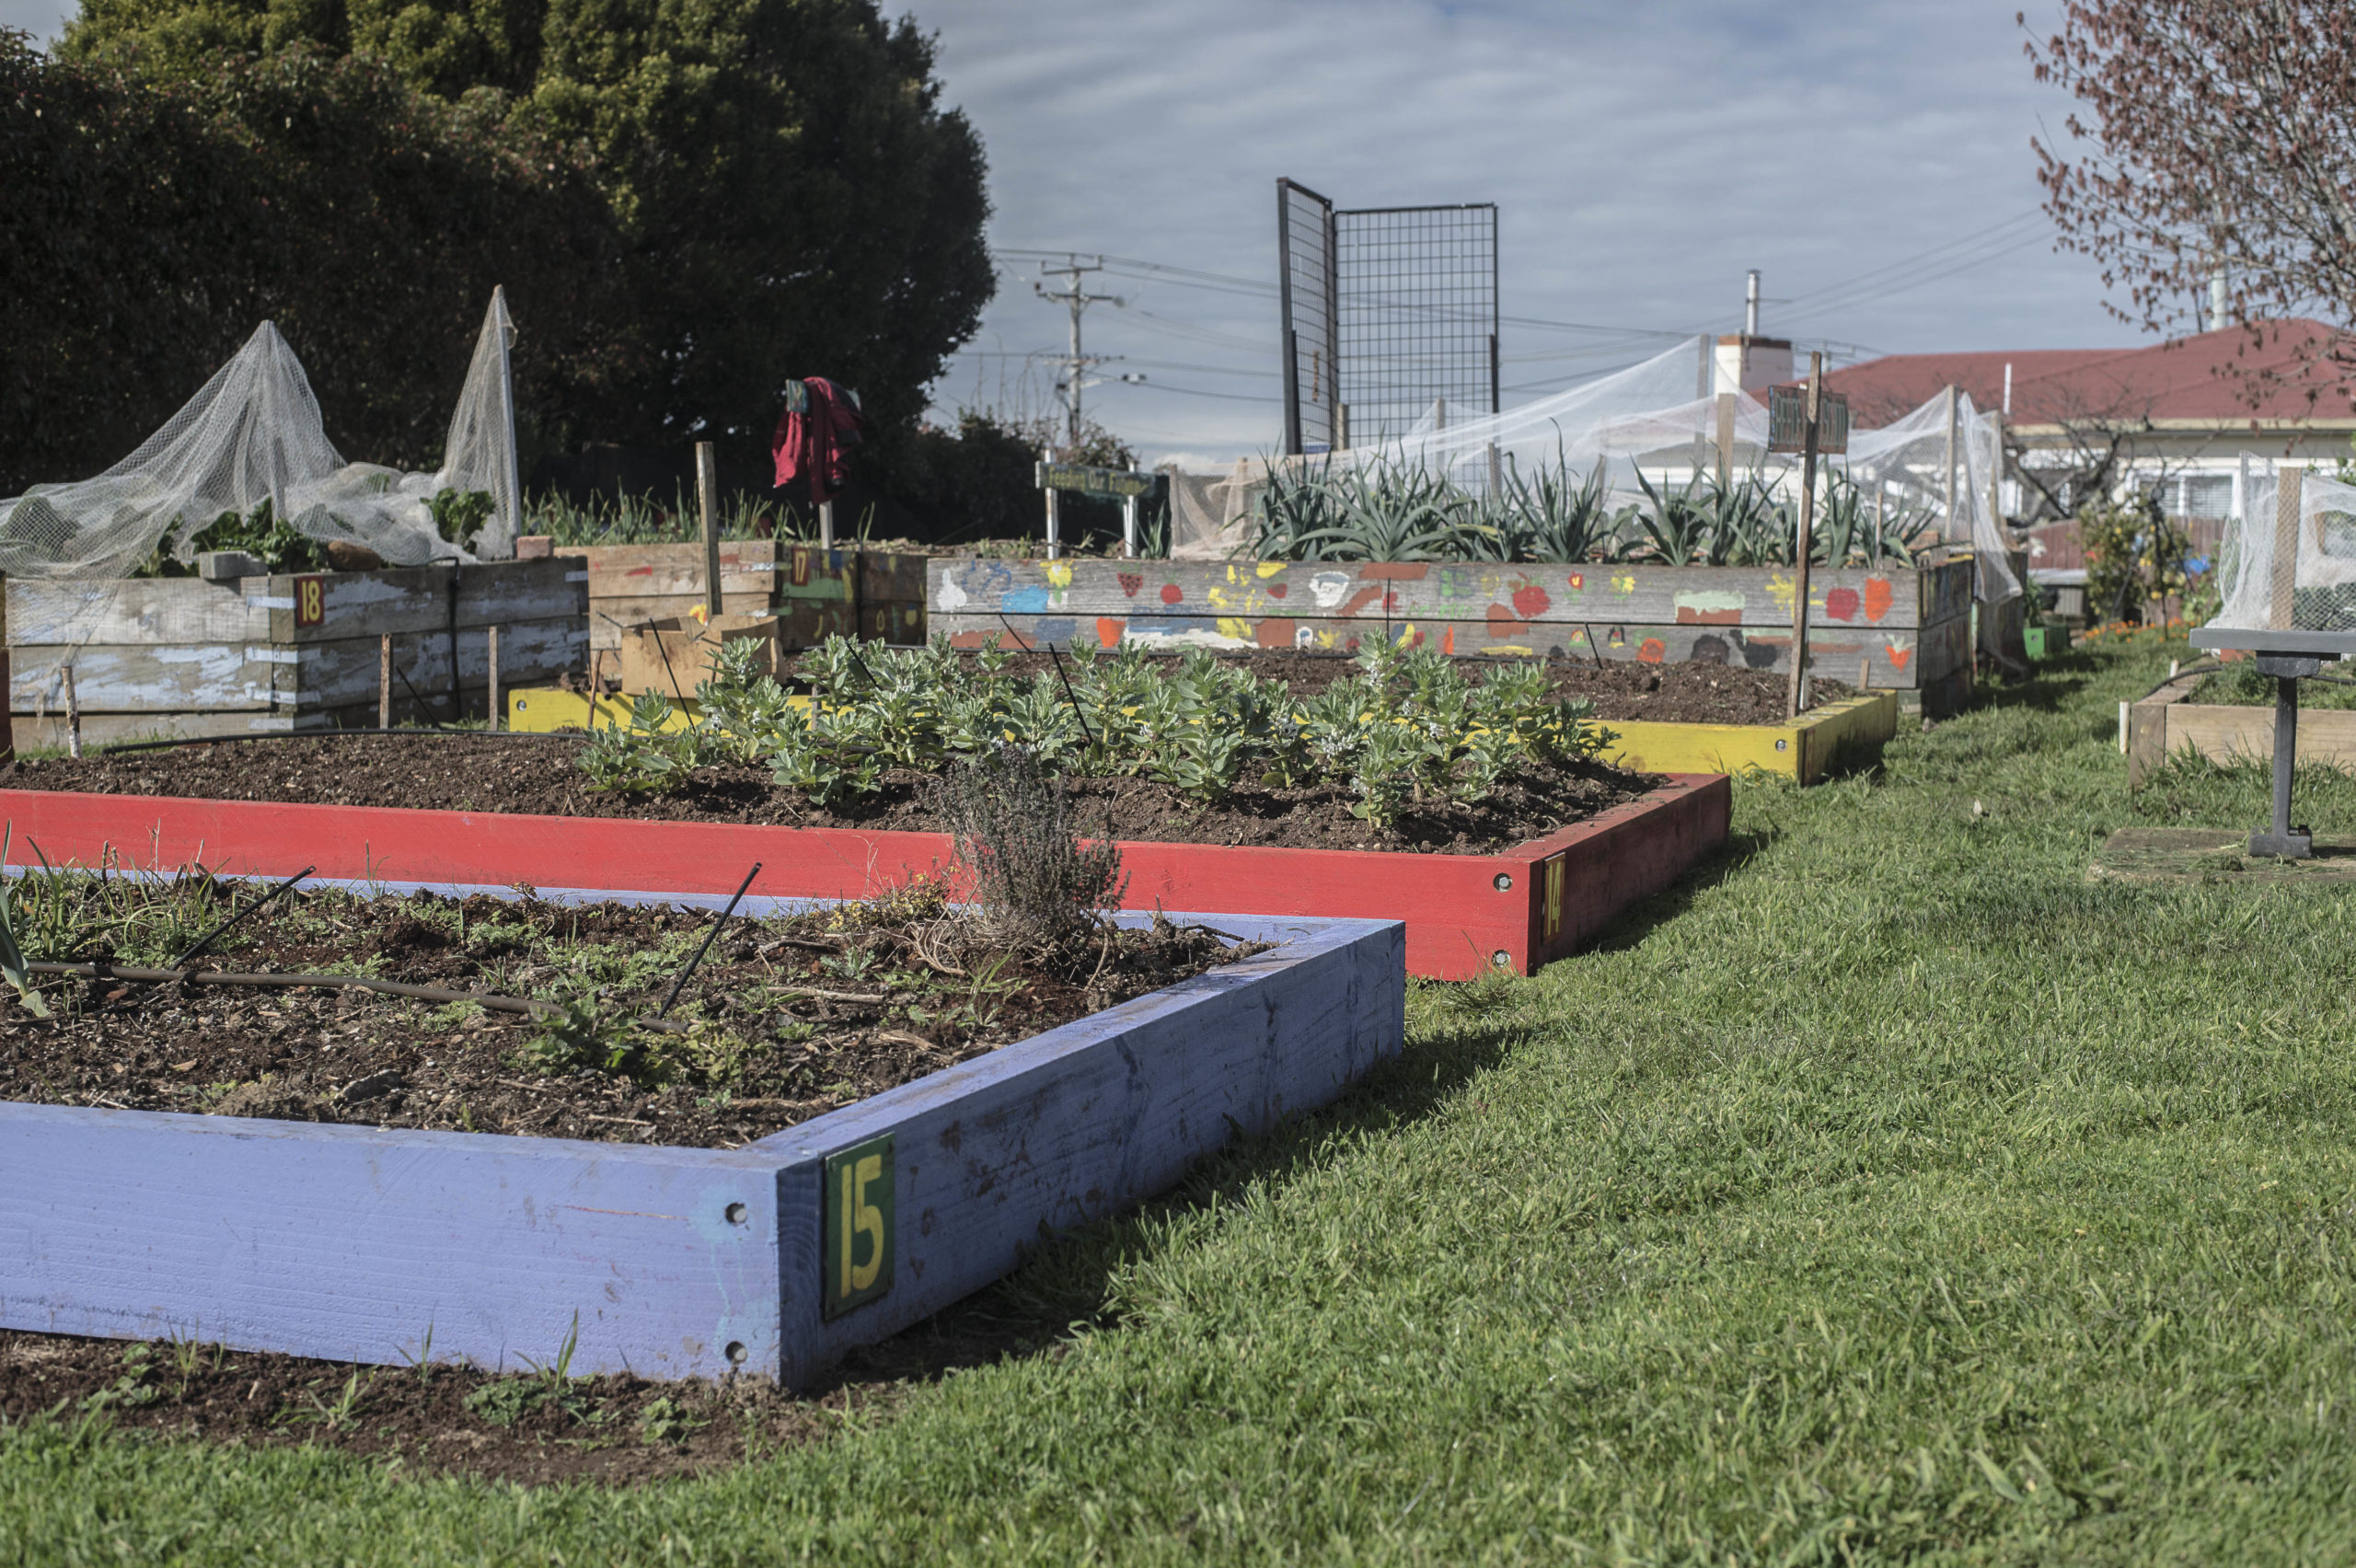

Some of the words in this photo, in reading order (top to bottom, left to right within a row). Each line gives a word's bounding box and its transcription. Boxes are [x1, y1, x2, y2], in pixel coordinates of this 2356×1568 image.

[1048, 466, 1085, 492] Feeding
[1088, 469, 1104, 490] Our
[795, 551, 806, 582] 17
[302, 580, 320, 621] 18
[1547, 861, 1561, 936] 14
[840, 1154, 884, 1298] 15
